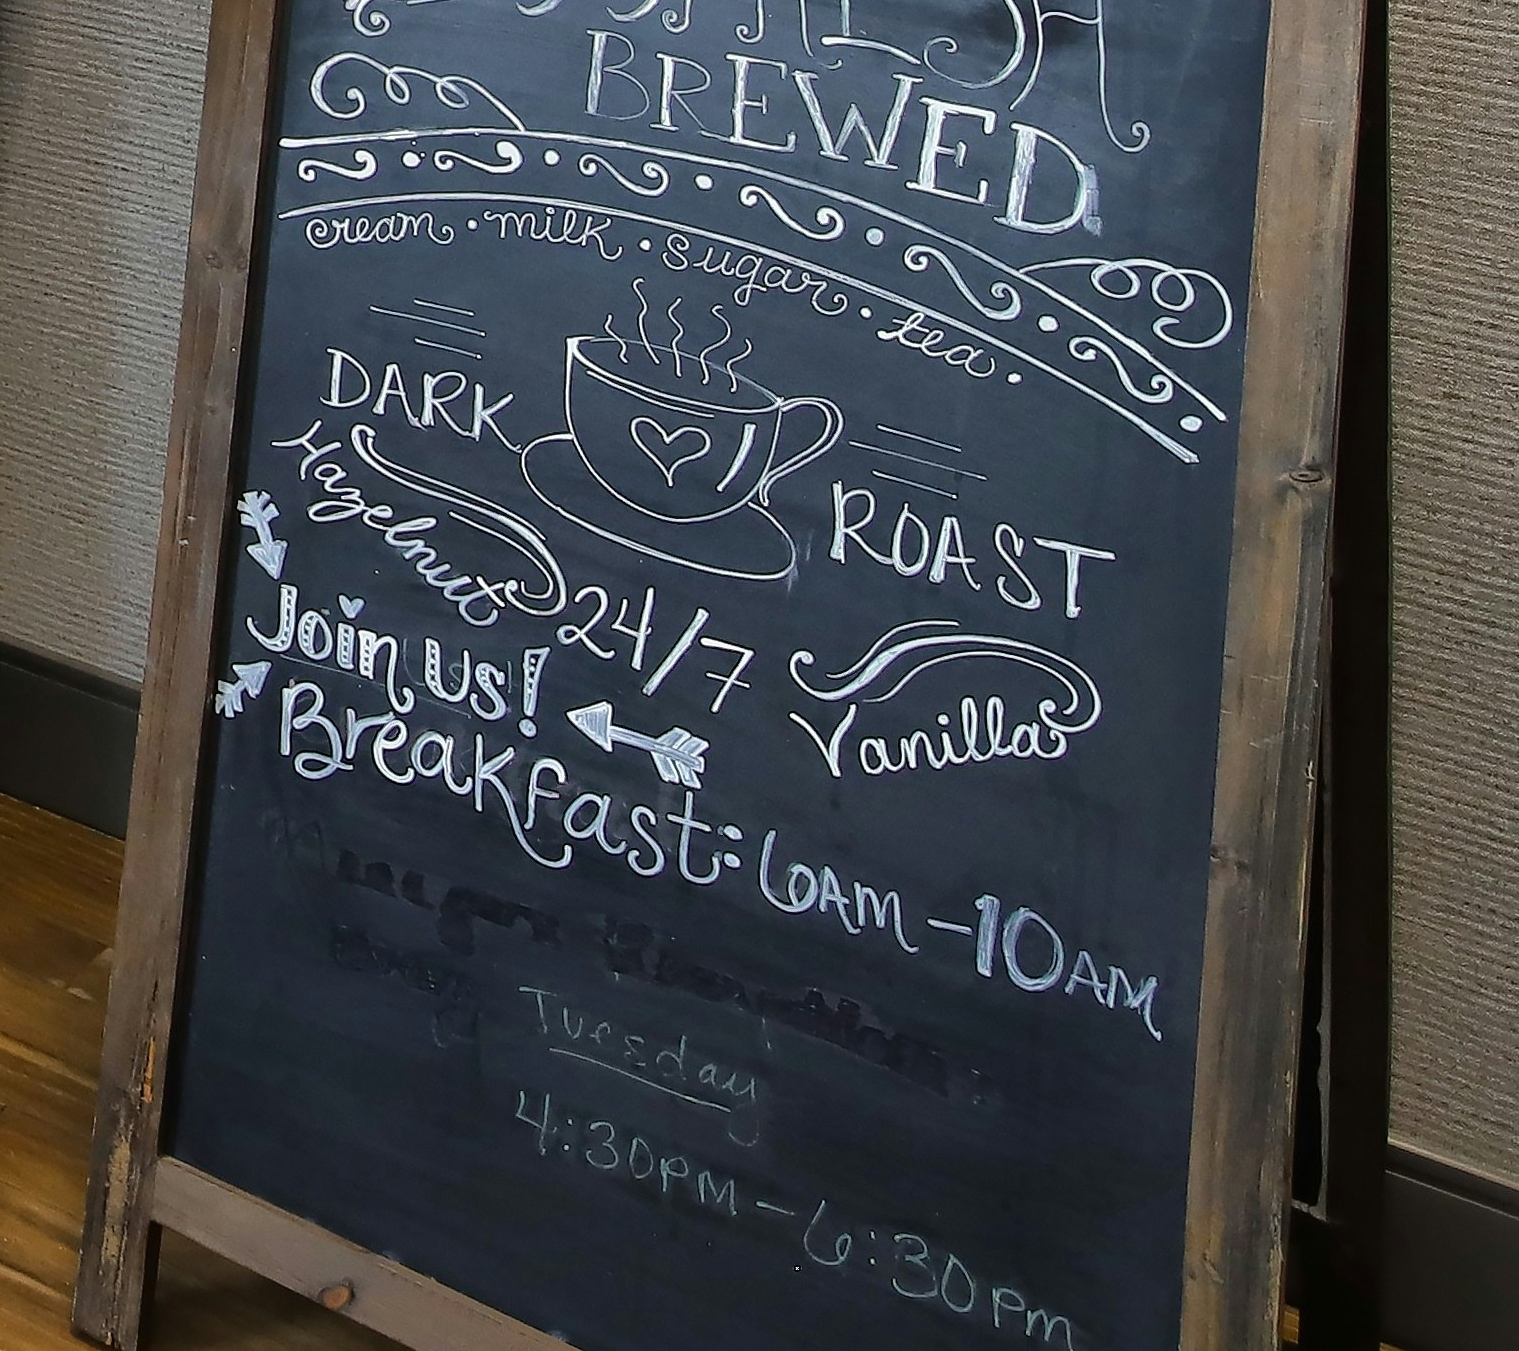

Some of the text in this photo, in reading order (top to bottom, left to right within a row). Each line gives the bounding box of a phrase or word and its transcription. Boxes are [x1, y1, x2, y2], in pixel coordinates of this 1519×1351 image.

[584, 28, 1096, 235] BREWED
[305, 209, 454, 248] cream
[483, 205, 624, 261] milk
[877, 312, 996, 380] tea
[320, 347, 522, 453] DARK
[271, 420, 510, 627] Hazelnut
[829, 480, 1116, 618] ROAST
[246, 584, 415, 714] Join
[555, 585, 754, 713] 24/7
[279, 681, 744, 885] Breakfast:
[789, 695, 1068, 777] Vanilla
[518, 985, 759, 1146] Tuesday
